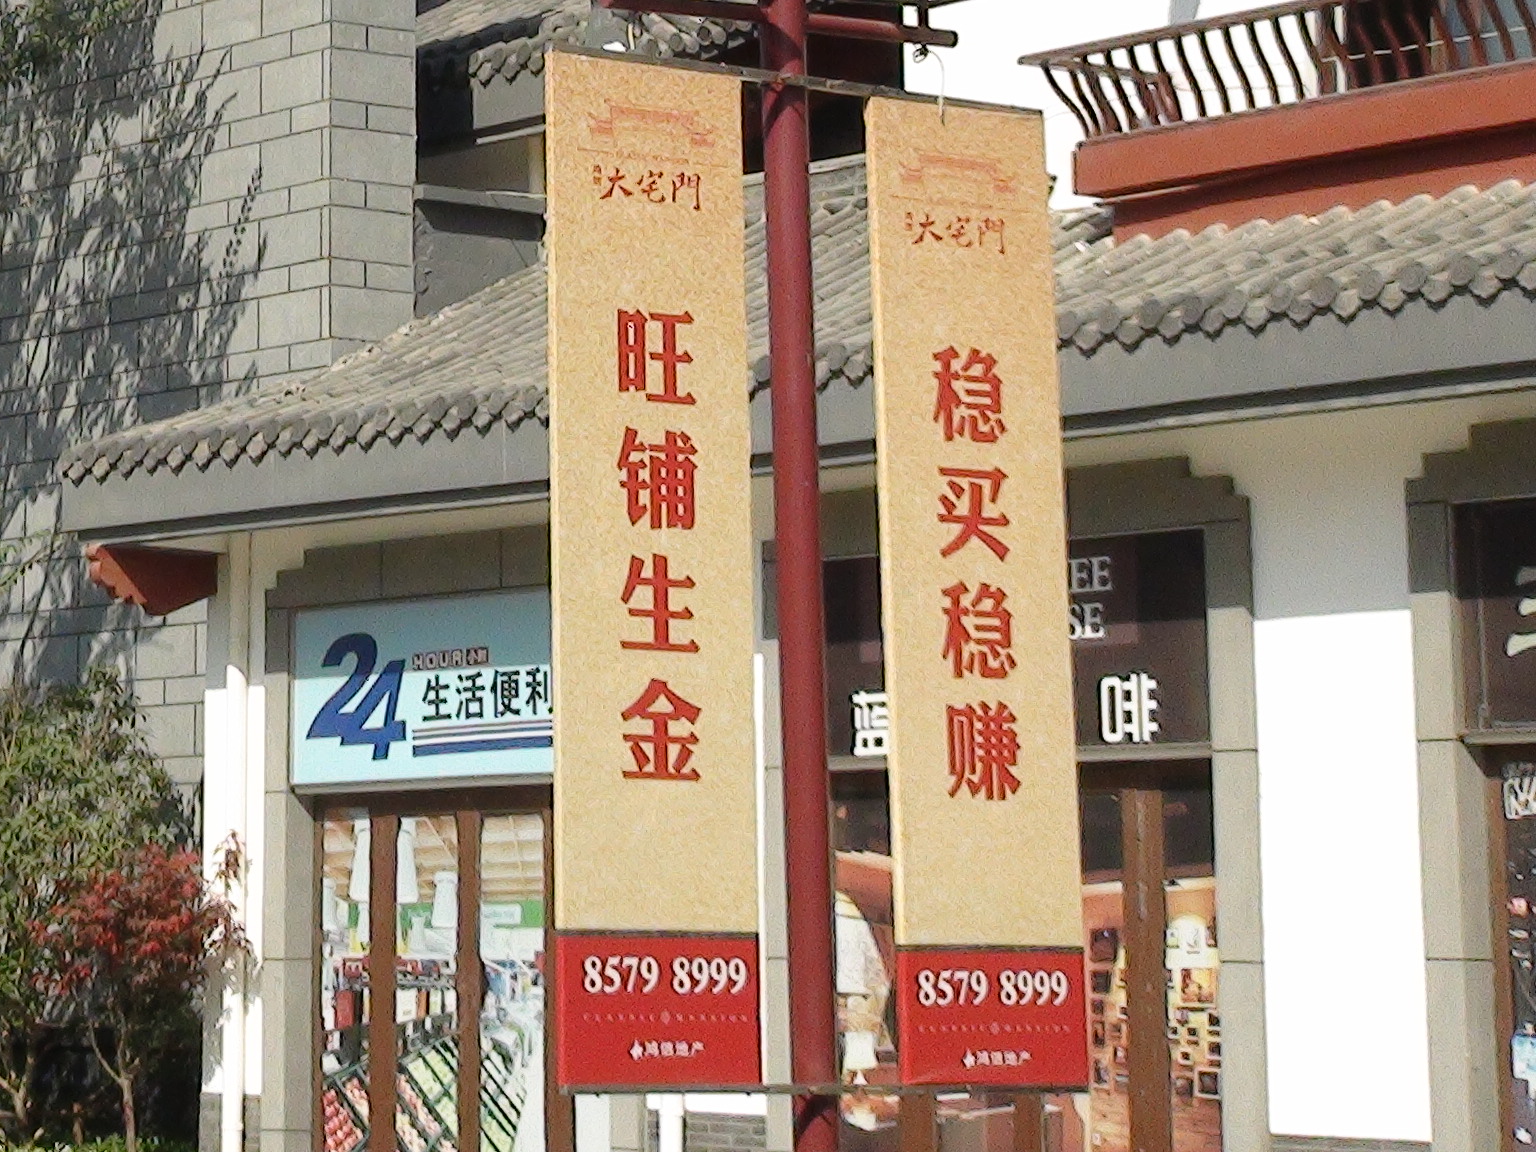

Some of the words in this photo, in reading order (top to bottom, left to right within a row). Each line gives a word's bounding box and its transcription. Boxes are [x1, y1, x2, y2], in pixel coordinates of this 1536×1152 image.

[616, 309, 702, 781] 旺铺生金
[932, 346, 1022, 801] 稳买稳赚
[306, 632, 406, 760] 24
[583, 955, 659, 994] 8579
[672, 956, 748, 995] 8999
[917, 969, 989, 1007] 8579
[999, 970, 1069, 1006] 8999
